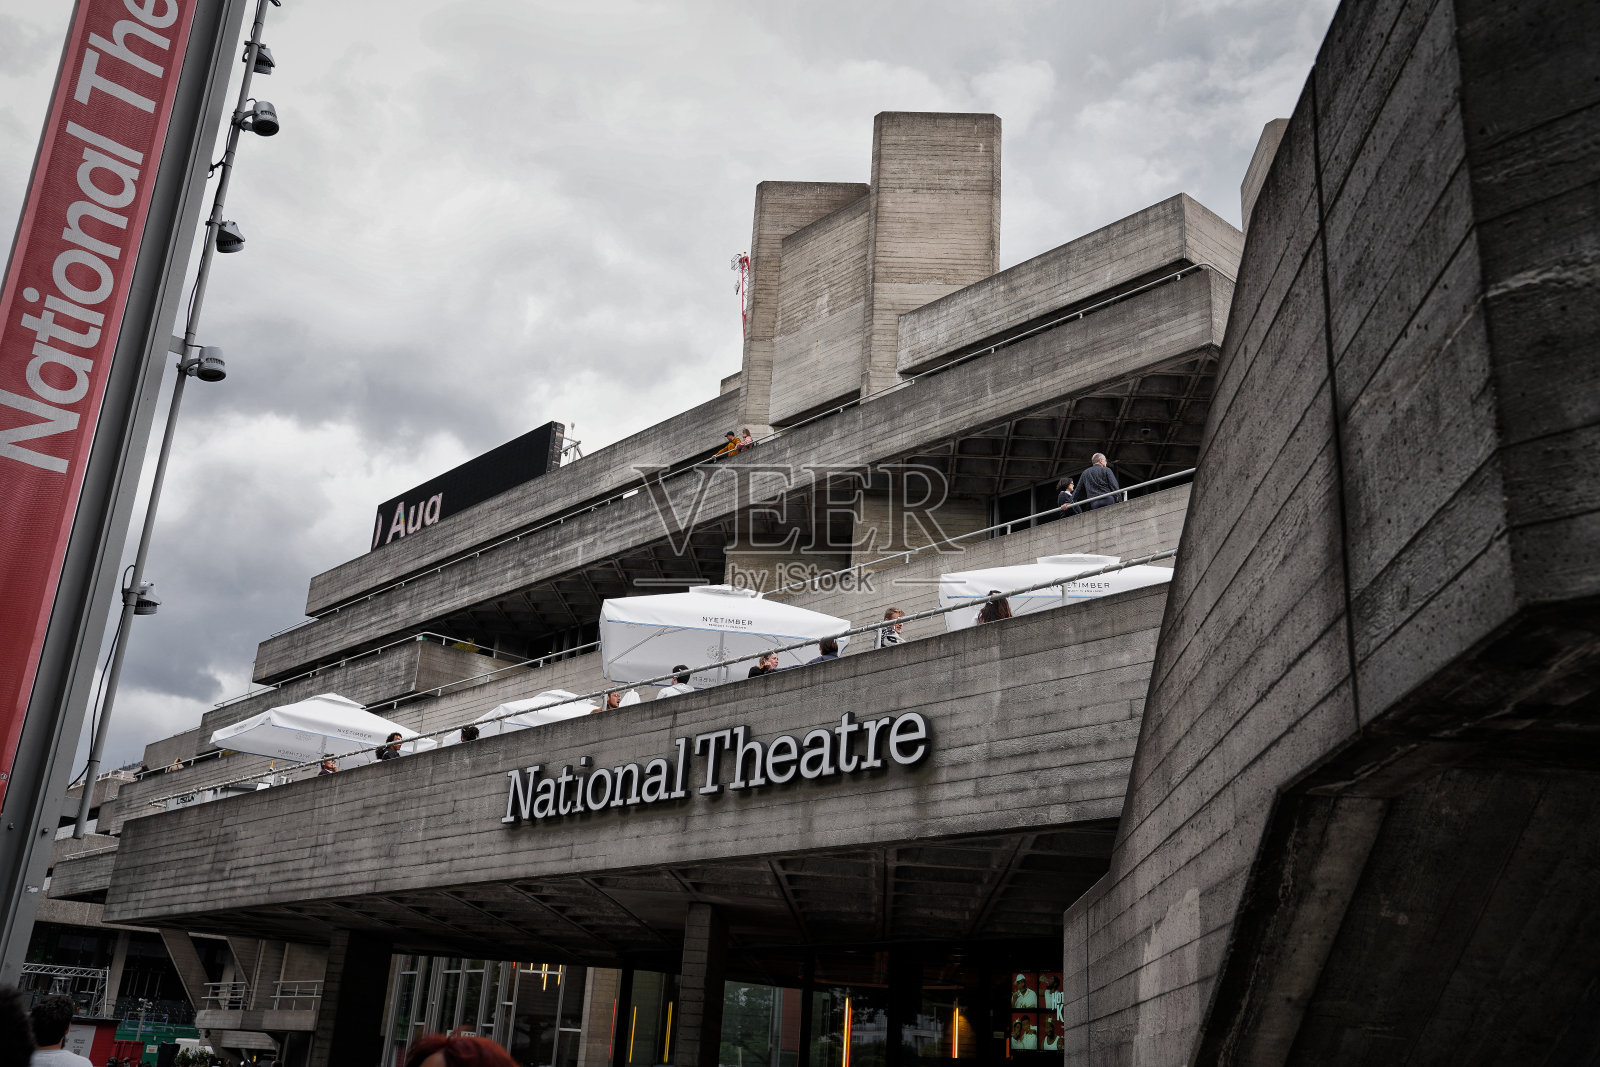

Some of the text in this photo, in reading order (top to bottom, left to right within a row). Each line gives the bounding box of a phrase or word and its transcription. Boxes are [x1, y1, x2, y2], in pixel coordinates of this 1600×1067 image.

[0, 120, 144, 474] National
[702, 616, 753, 626] NYETIMBER
[500, 711, 930, 824] National Theatre
